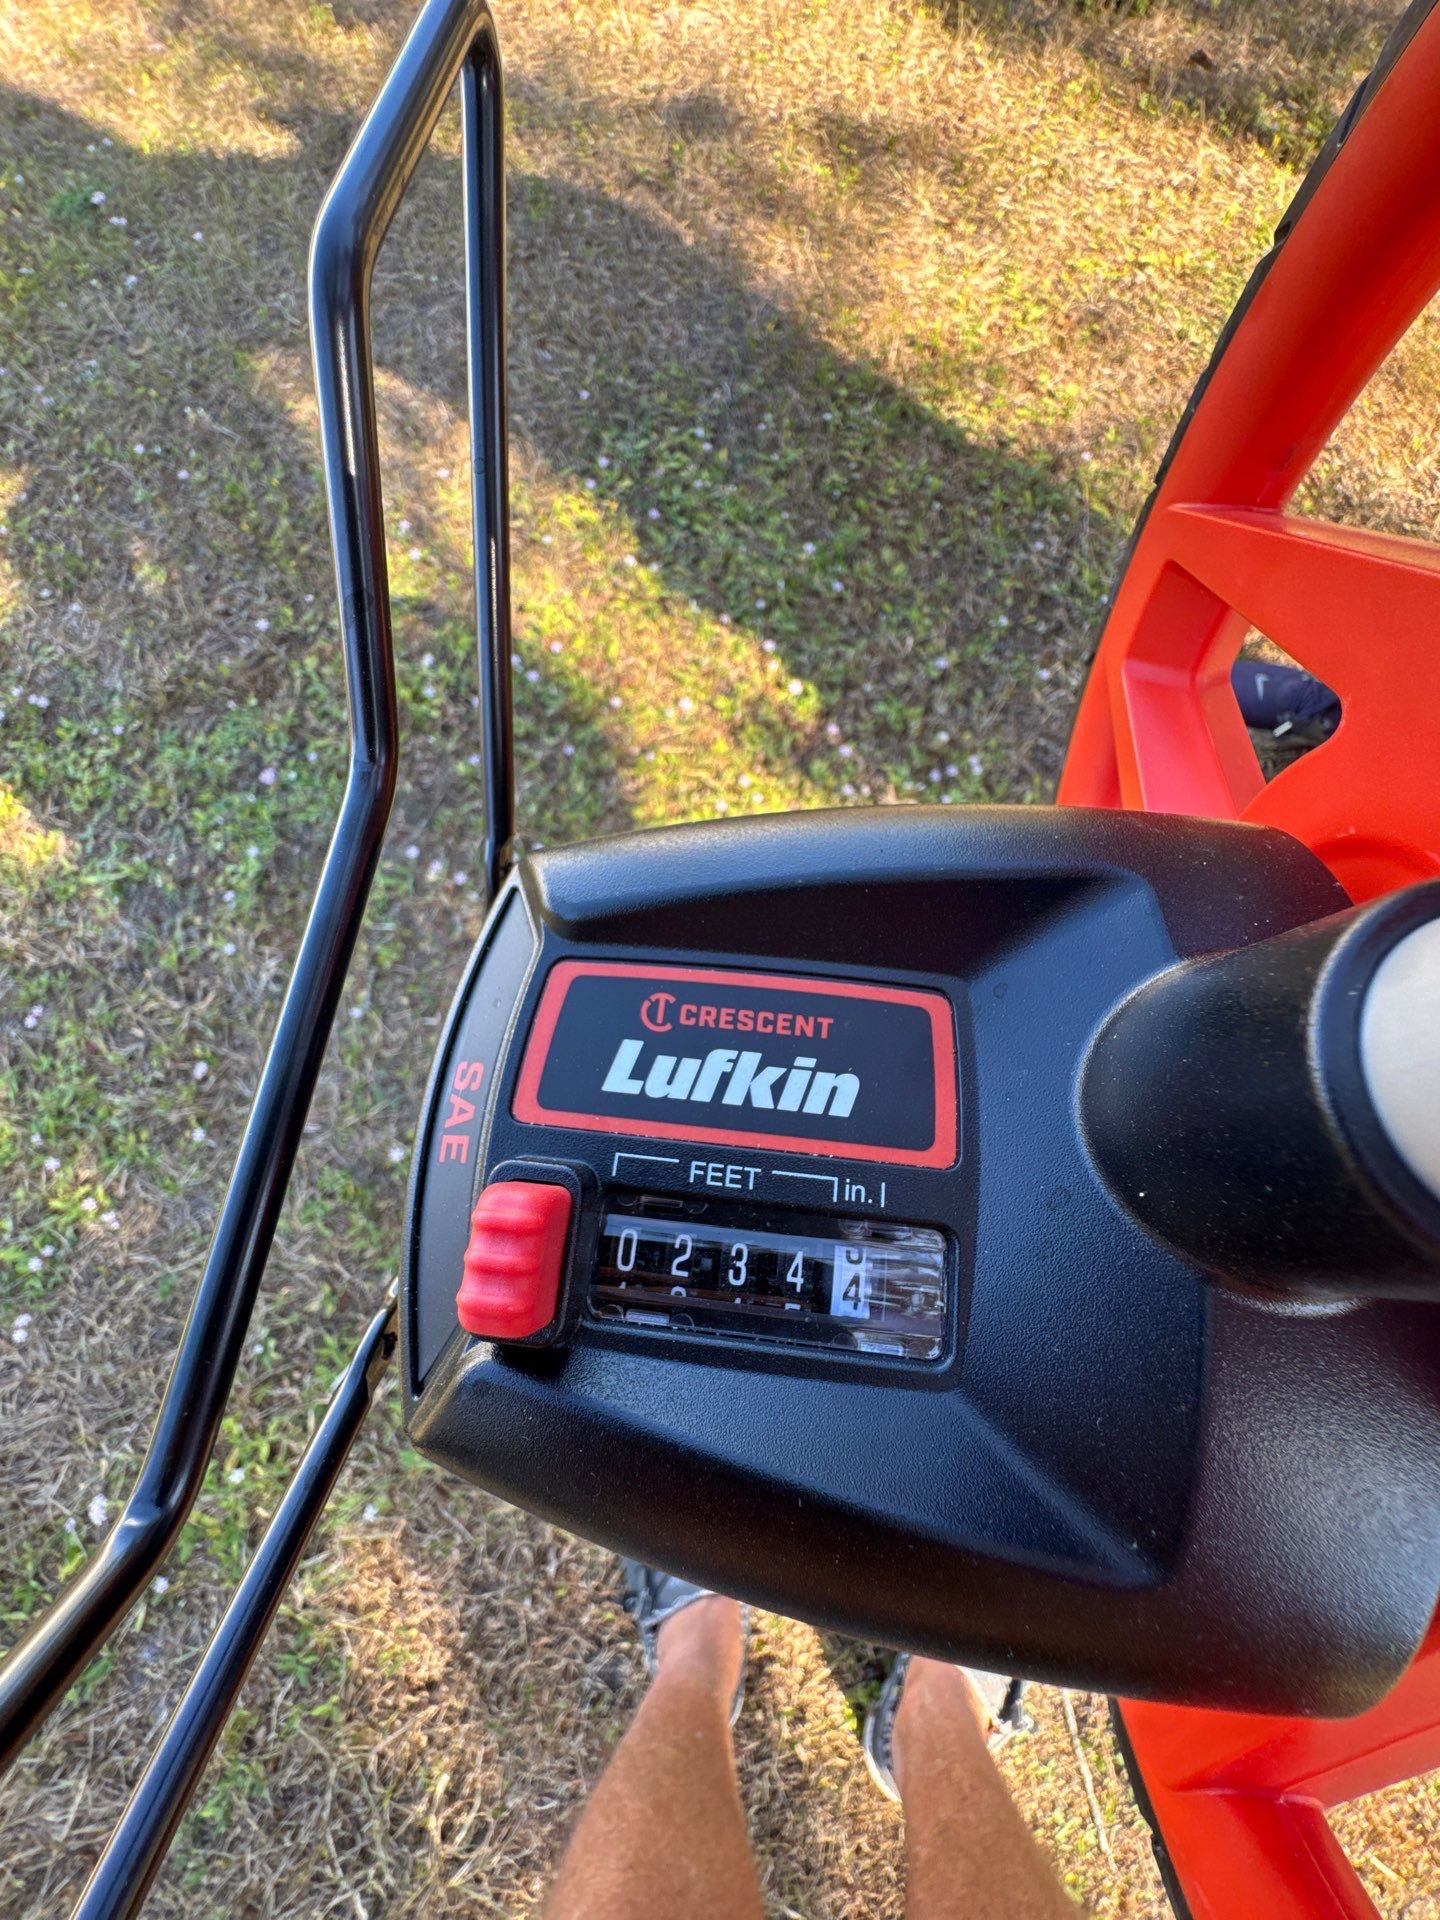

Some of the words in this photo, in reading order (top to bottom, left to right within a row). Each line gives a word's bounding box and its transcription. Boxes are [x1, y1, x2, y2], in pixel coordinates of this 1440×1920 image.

[679, 1004, 834, 1039] CRESCENT
[601, 1038, 860, 1118] Lufkin
[438, 1060, 482, 1164] SAE
[689, 1161, 762, 1190] FEET
